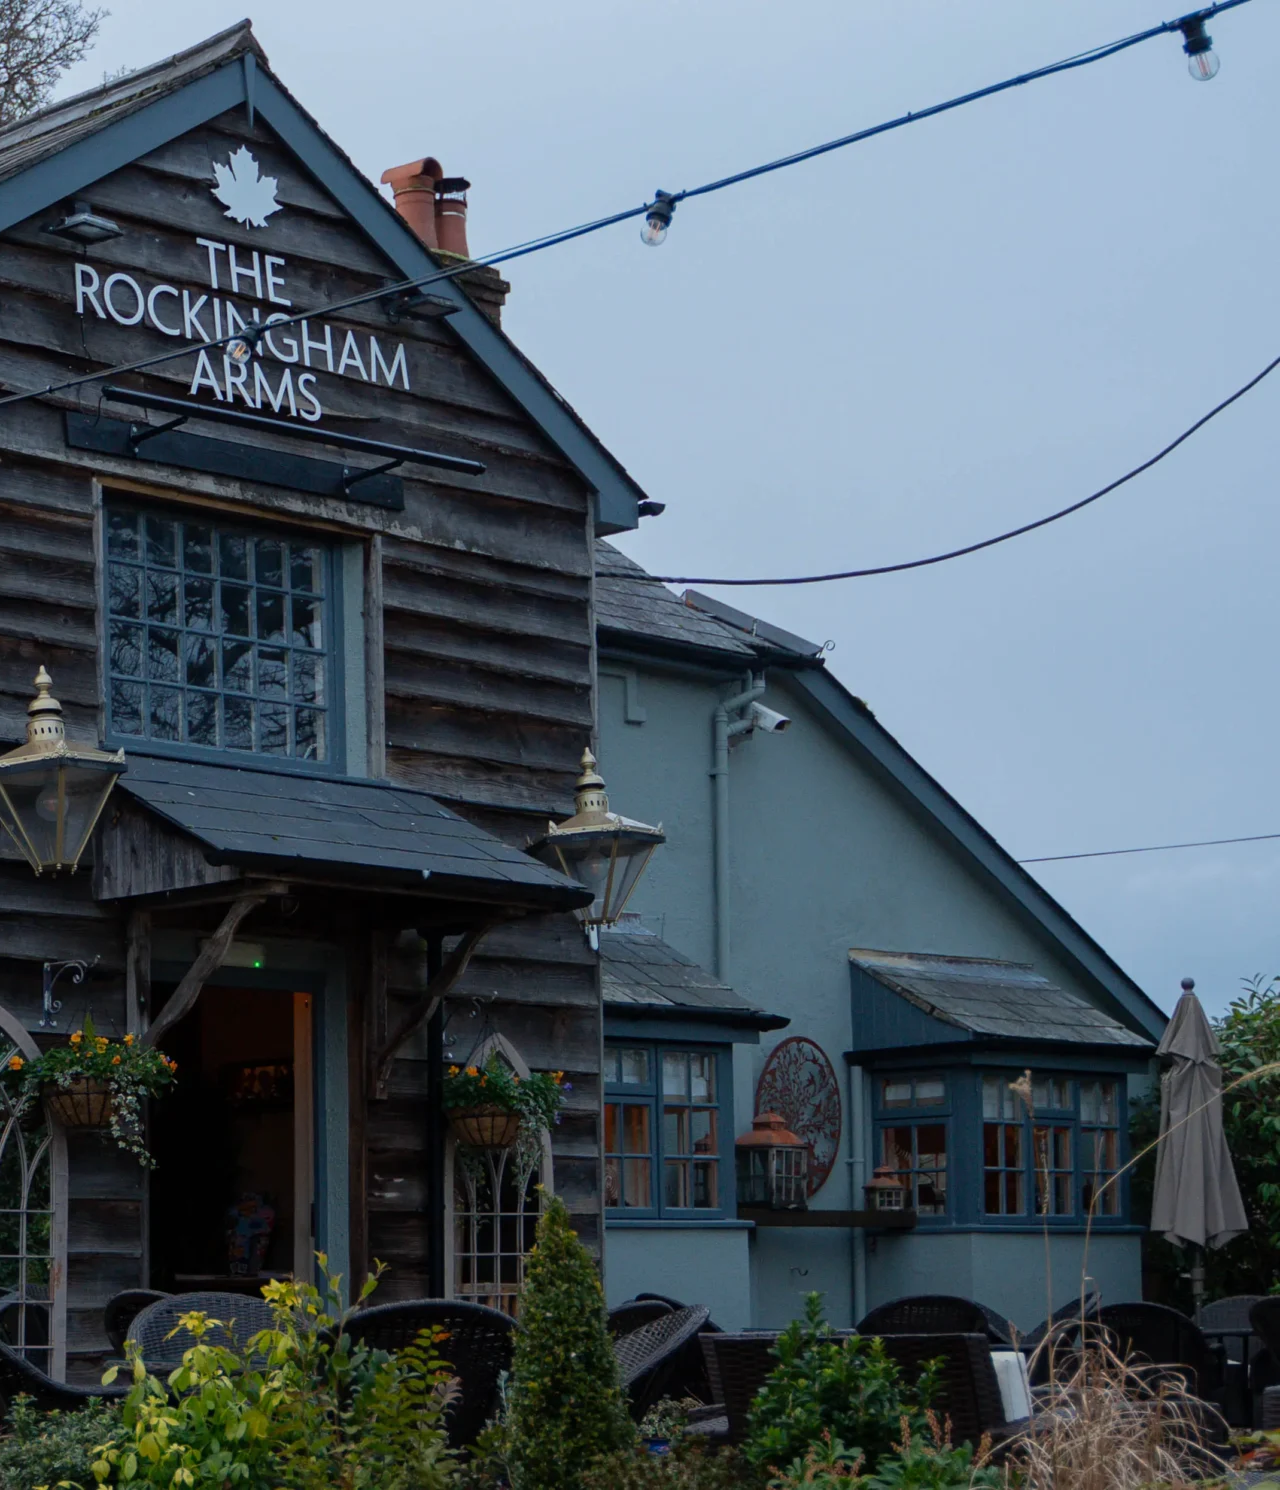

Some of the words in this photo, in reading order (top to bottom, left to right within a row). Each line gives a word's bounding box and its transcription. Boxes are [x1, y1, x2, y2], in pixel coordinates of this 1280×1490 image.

[196, 237, 291, 306] THE
[75, 263, 410, 390] ROCKINGHAM
[190, 349, 321, 421] ARMS
